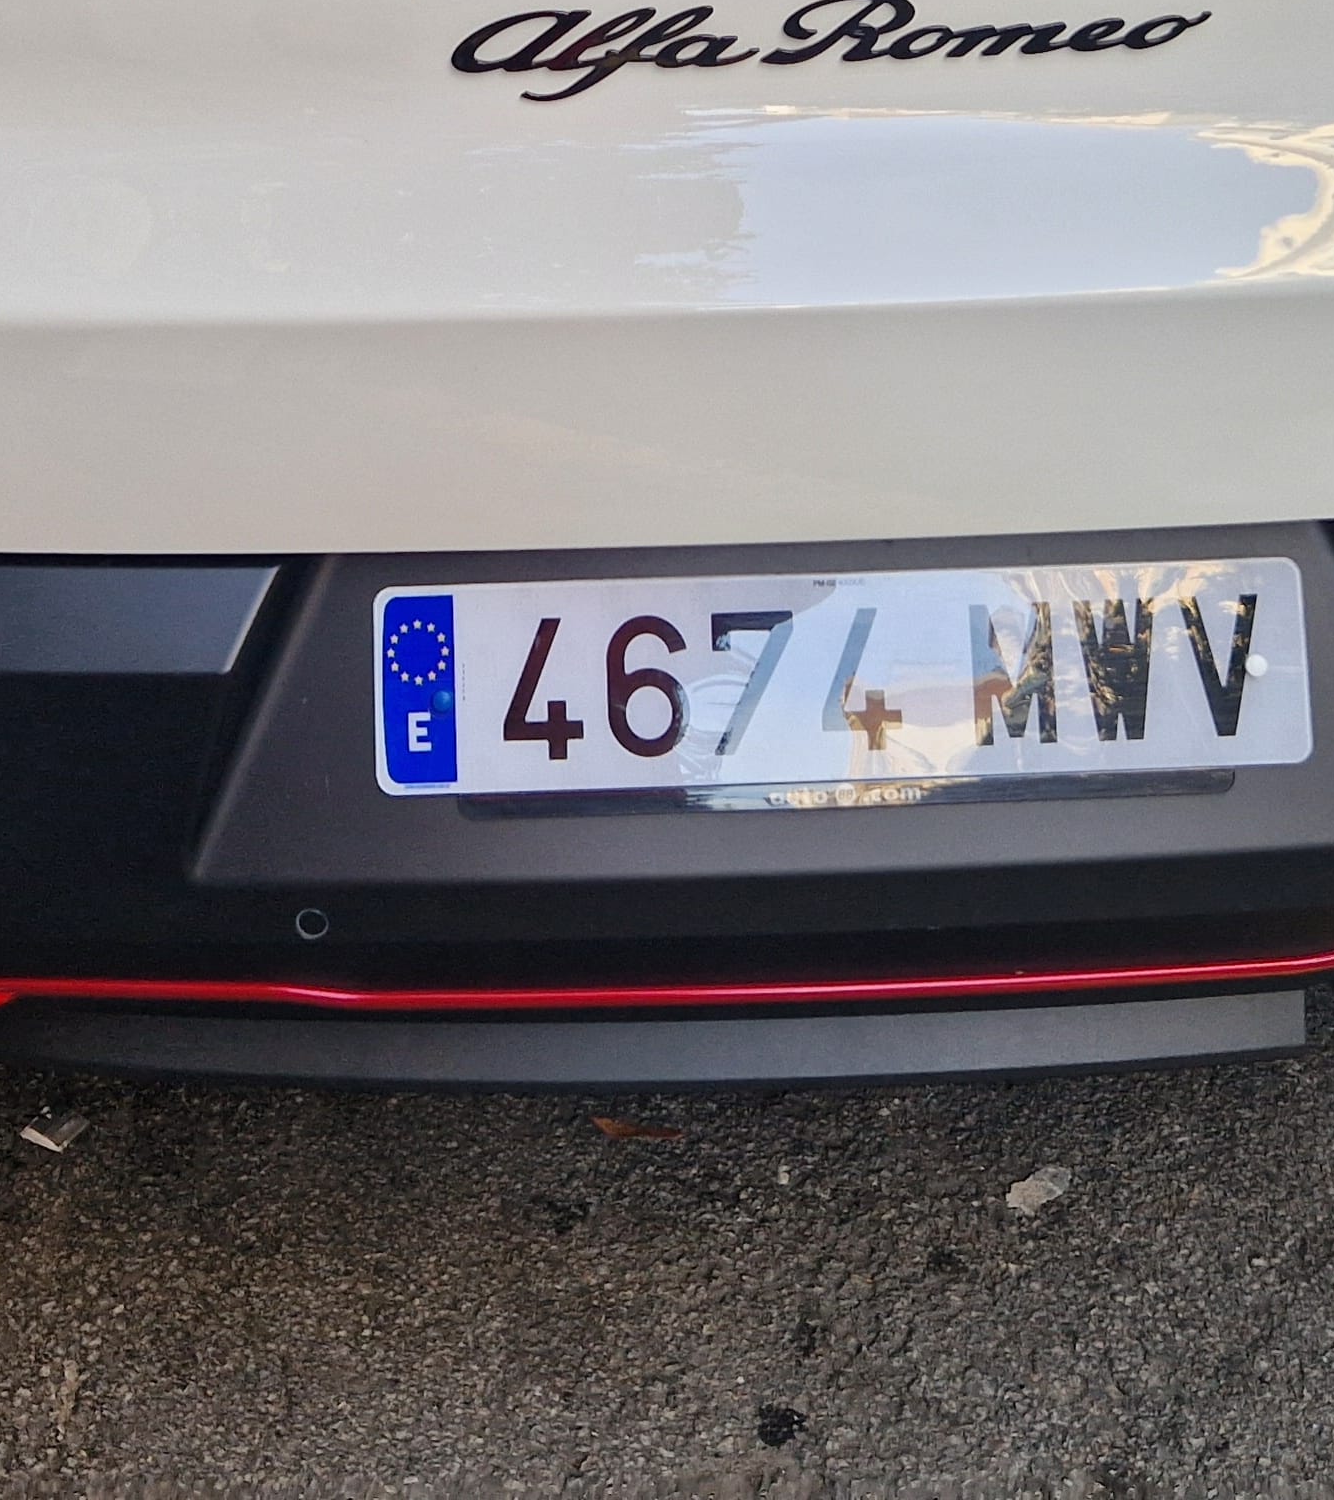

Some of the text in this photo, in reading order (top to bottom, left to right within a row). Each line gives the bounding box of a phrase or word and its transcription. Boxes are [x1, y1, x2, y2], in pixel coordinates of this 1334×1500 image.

[450, 5, 760, 102] Alfa
[407, 593, 1256, 762] E 4674 MWV
